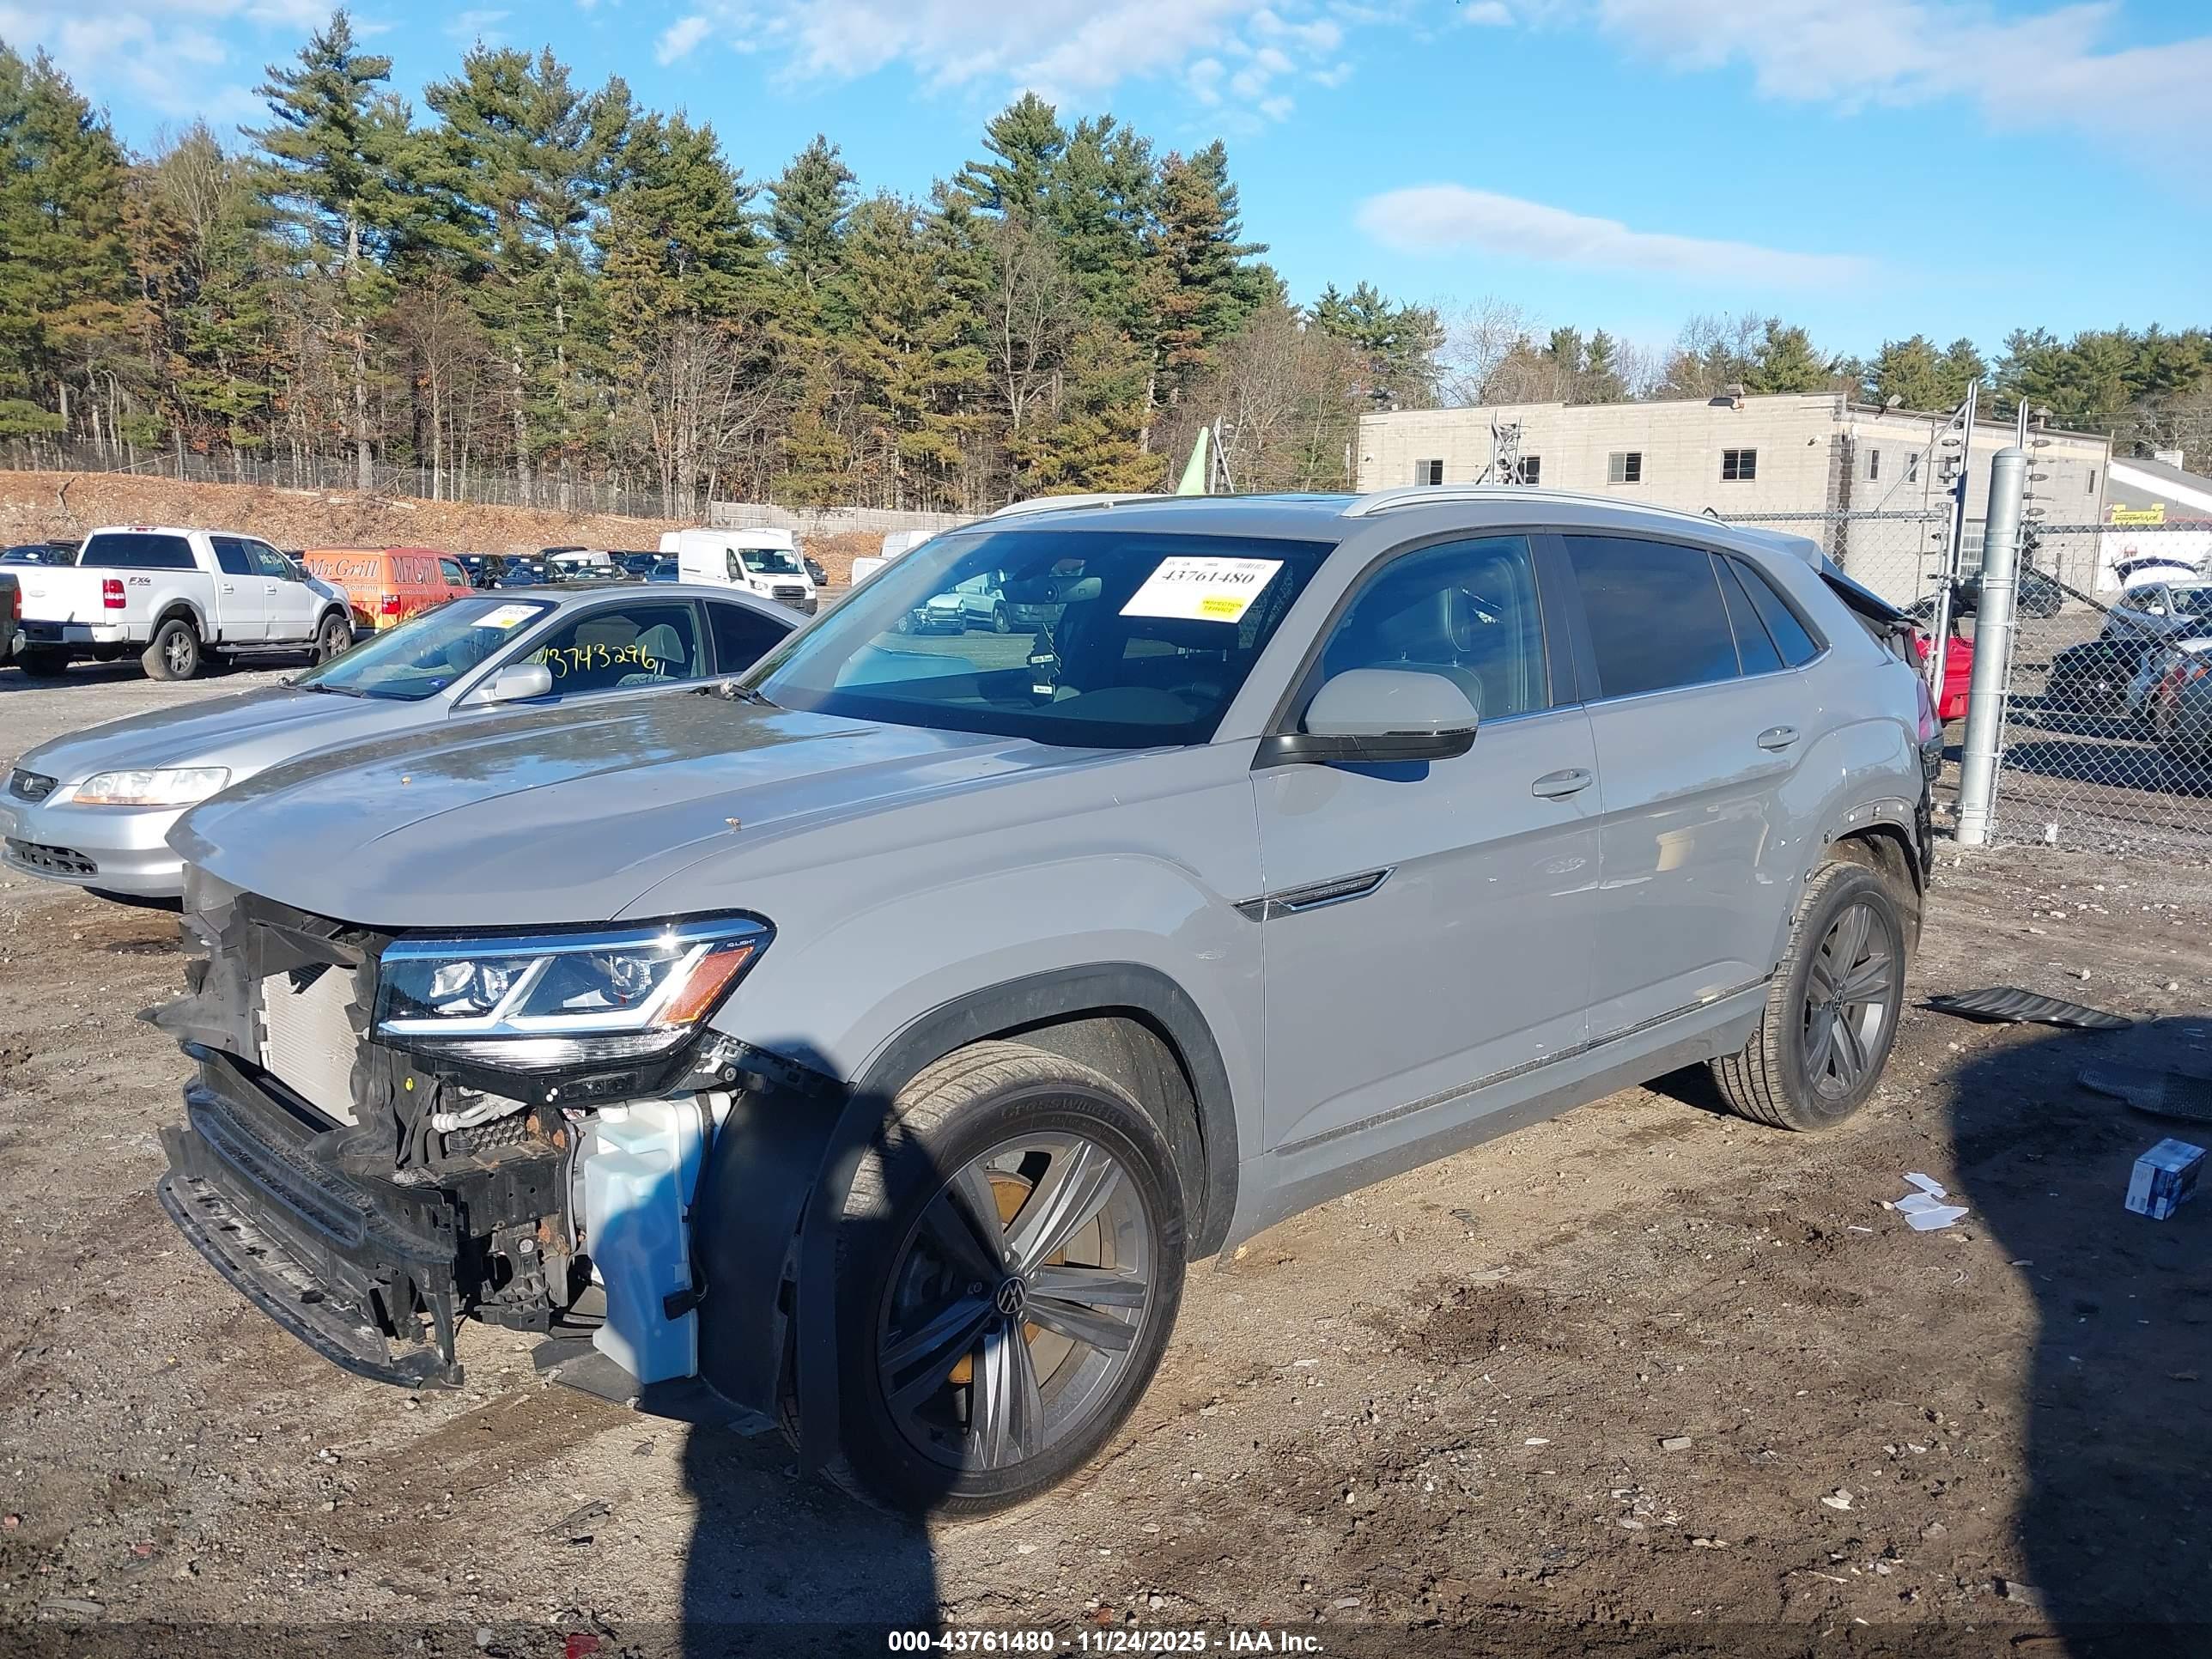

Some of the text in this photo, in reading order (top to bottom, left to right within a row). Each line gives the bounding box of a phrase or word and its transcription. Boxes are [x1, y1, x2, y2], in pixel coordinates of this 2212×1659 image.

[309, 558, 378, 577] Mr. Grill
[1162, 570, 1255, 584] 43761480
[343, 584, 378, 592] Cleaning
[1202, 599, 1243, 608] INSPECTION
